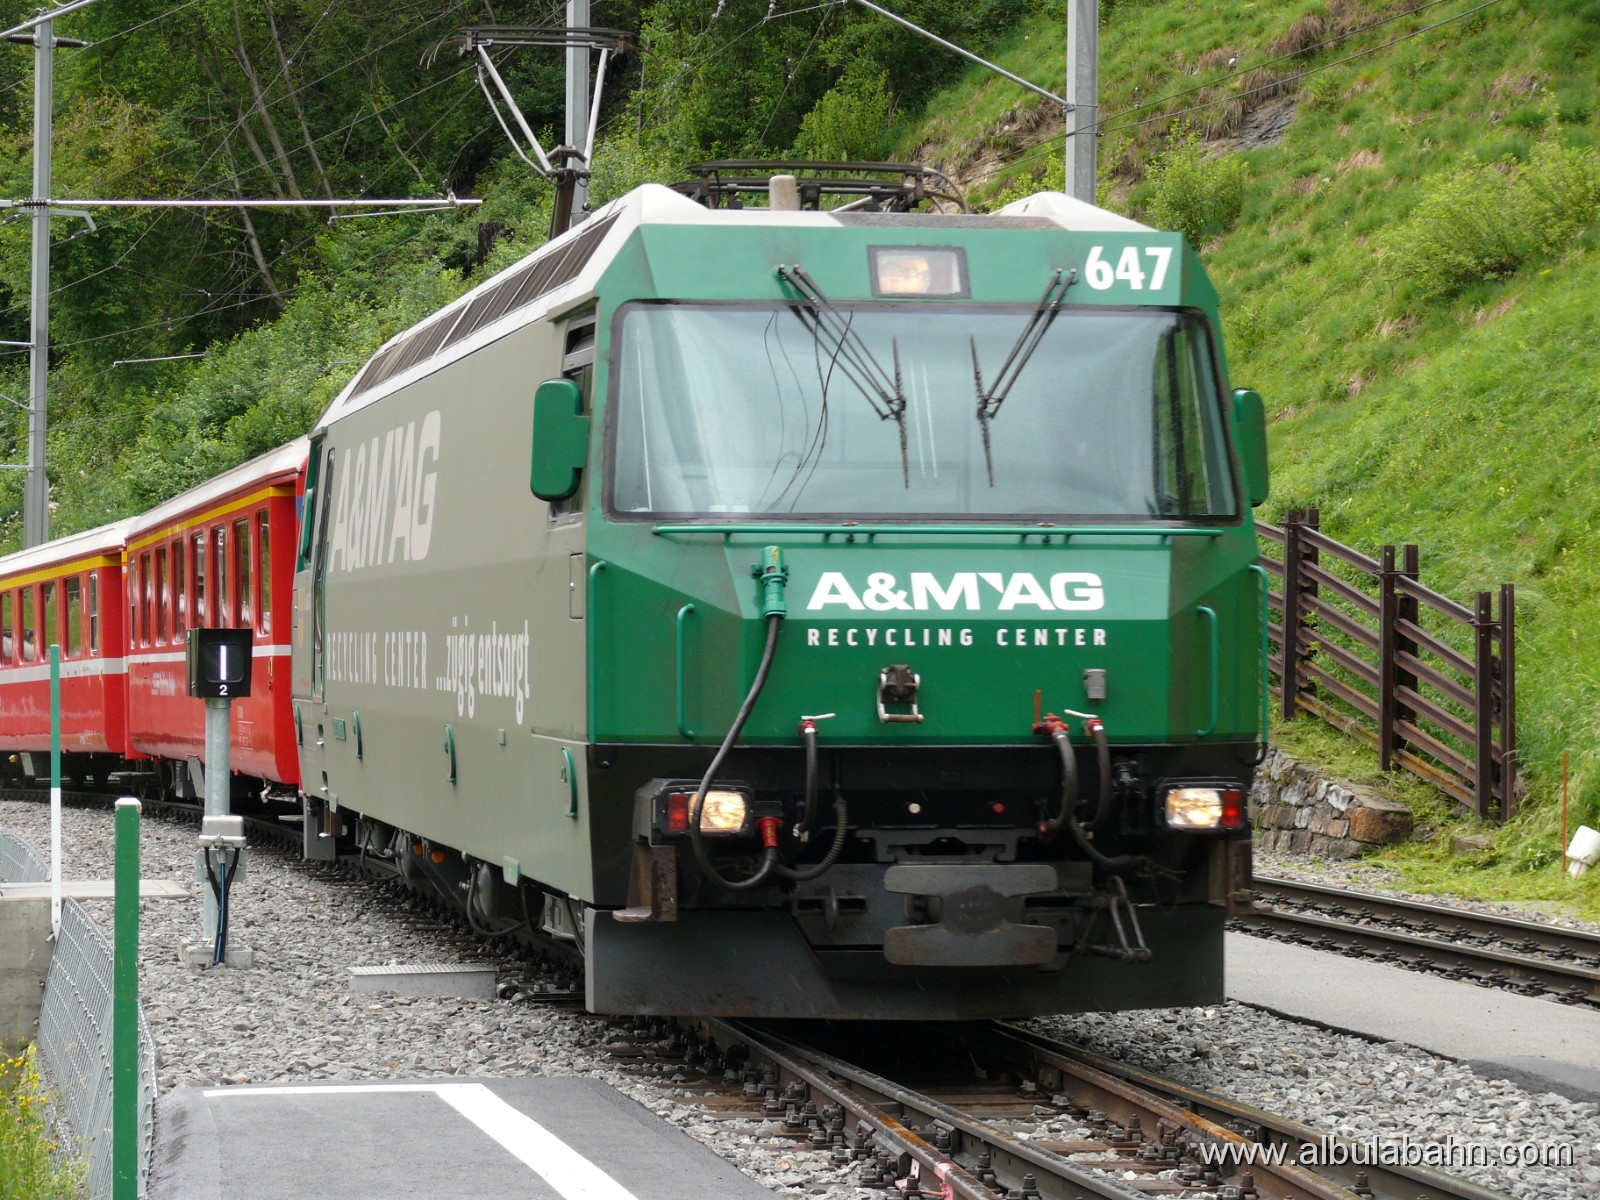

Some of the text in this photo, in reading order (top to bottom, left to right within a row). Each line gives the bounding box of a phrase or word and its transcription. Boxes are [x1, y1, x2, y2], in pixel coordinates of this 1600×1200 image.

[1085, 246, 1174, 290] 647
[807, 628, 1107, 647] RECYCLING CENTER
[326, 631, 427, 689] RECYCLING CENTER
[478, 619, 530, 725] entsorgt
[219, 684, 228, 695] 2
